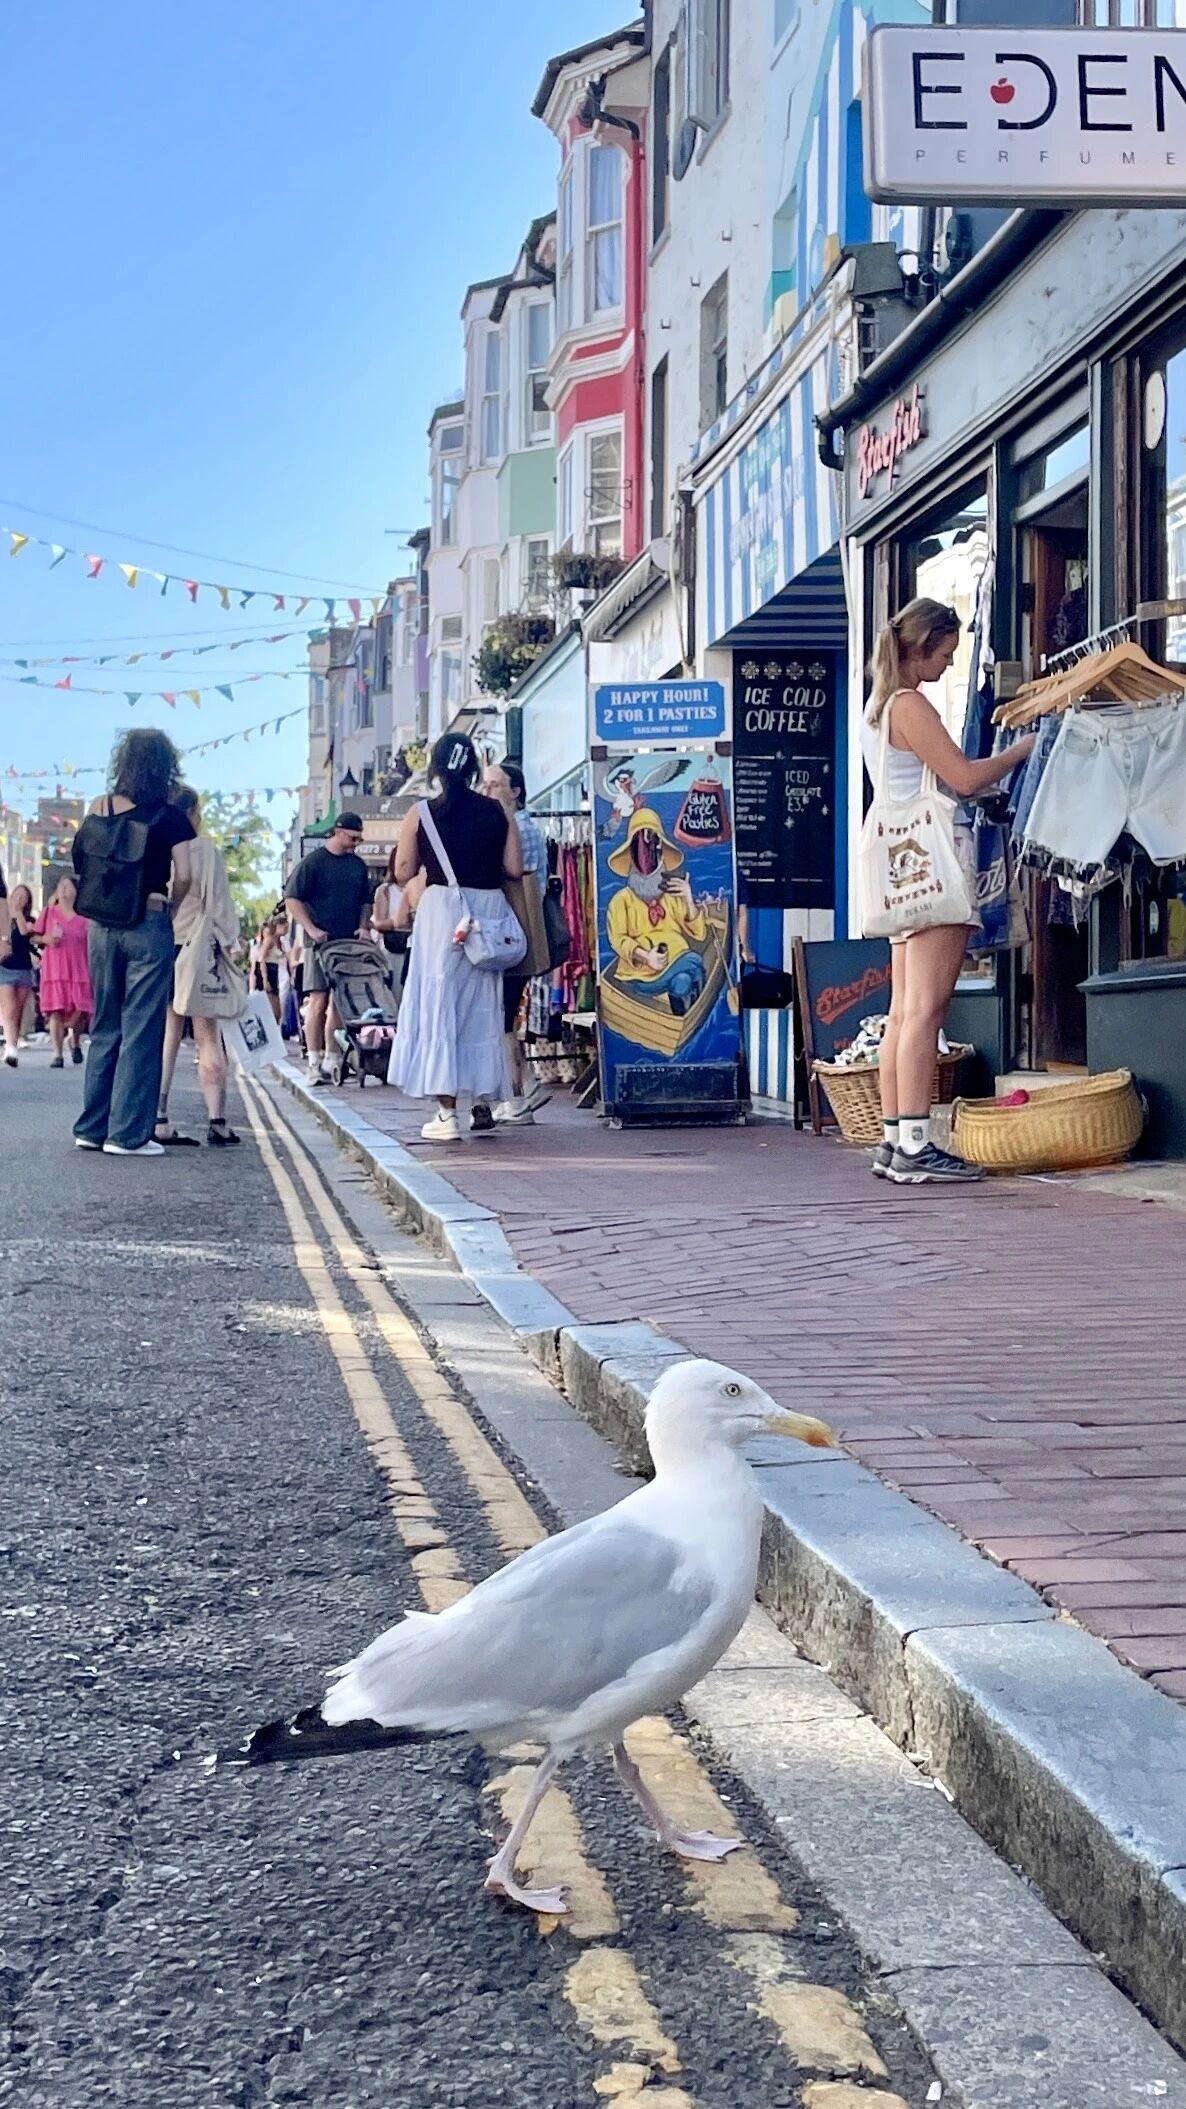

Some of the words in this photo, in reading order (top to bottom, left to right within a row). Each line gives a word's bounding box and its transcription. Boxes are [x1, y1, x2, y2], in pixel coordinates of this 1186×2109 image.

[610, 690, 659, 706] HAPPY
[663, 688, 709, 703] HOUR!
[744, 686, 773, 706] ICE
[782, 686, 827, 708] COLD
[603, 708, 614, 724] 2
[616, 708, 643, 722] FOR
[646, 708, 654, 722] 1
[658, 706, 717, 721] PASTIES
[745, 709, 810, 733] COFFEE
[785, 770, 810, 784] ICED
